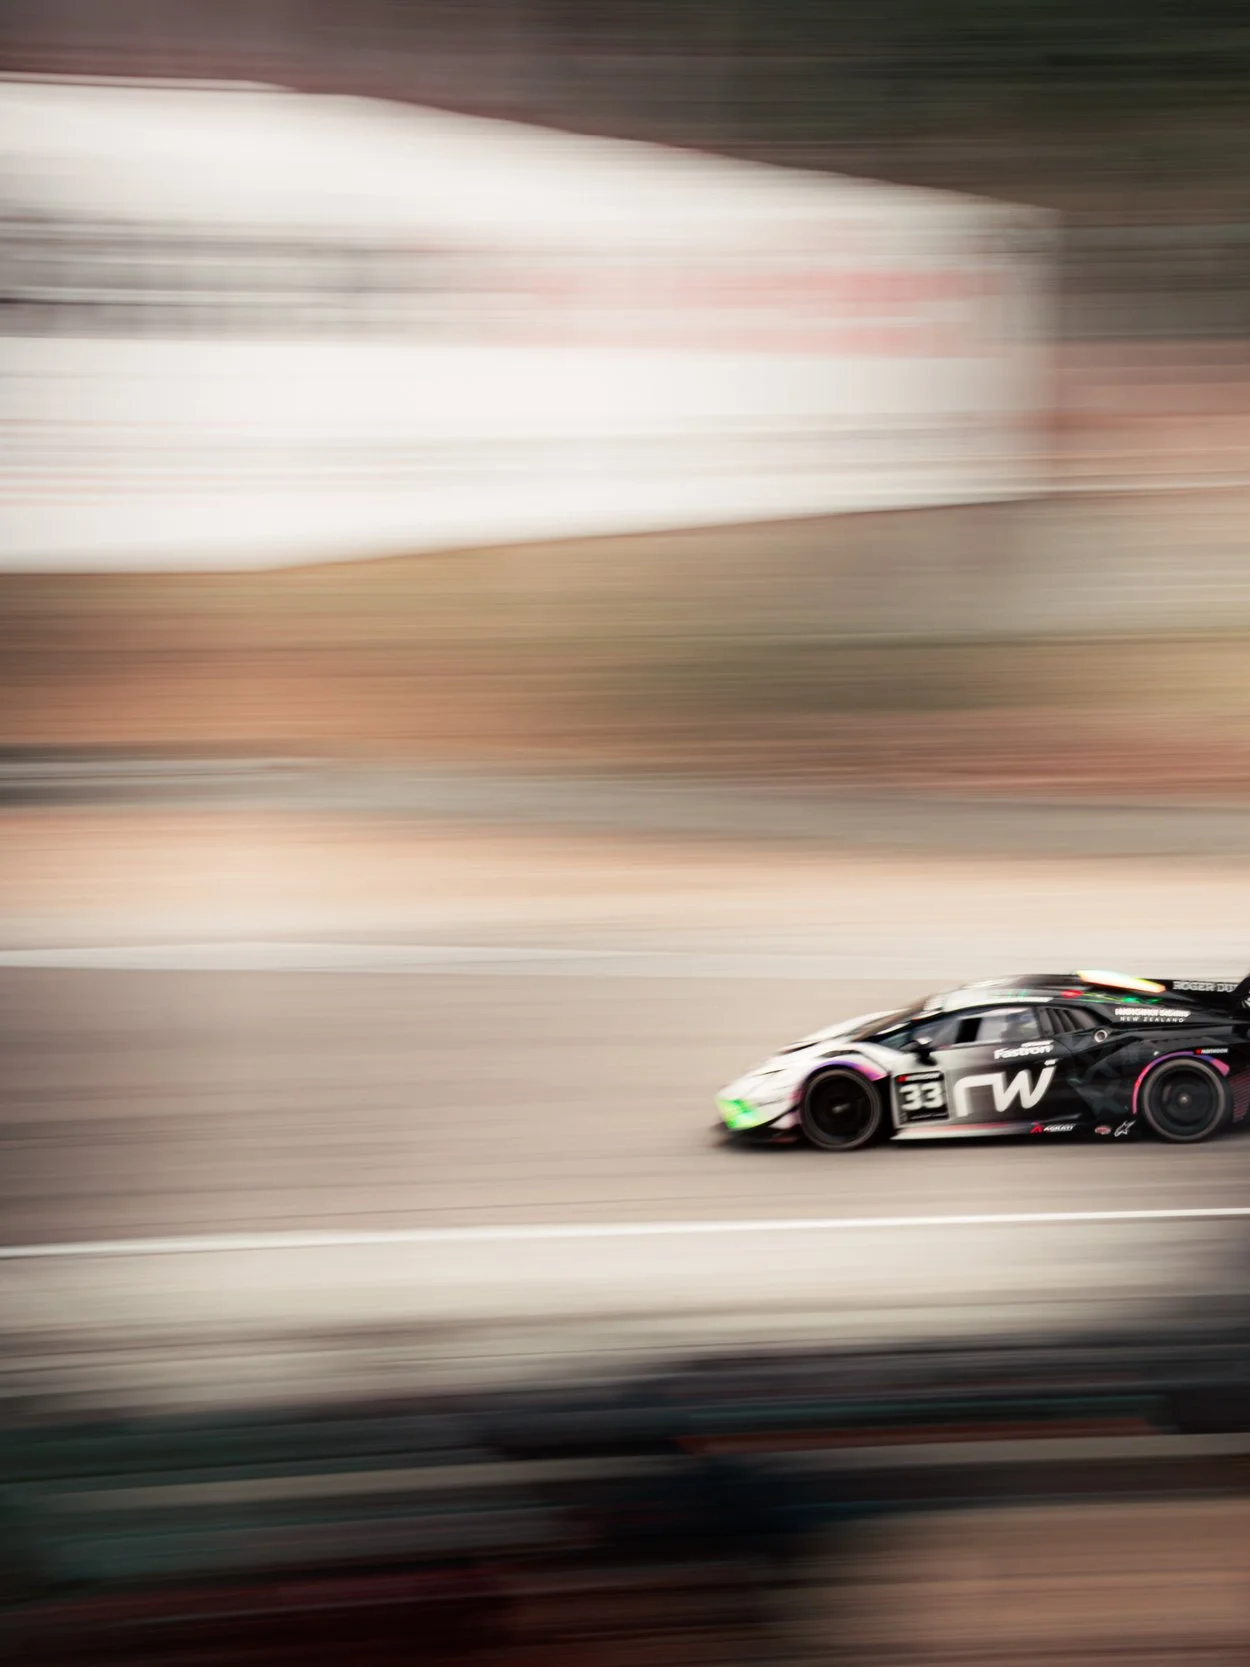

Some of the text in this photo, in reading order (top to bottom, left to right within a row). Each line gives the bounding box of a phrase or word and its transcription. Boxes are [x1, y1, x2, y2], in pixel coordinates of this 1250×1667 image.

[1173, 981, 1214, 991] ROGER
[994, 1045, 1053, 1059] Fastron
[900, 1078, 943, 1110] 33
